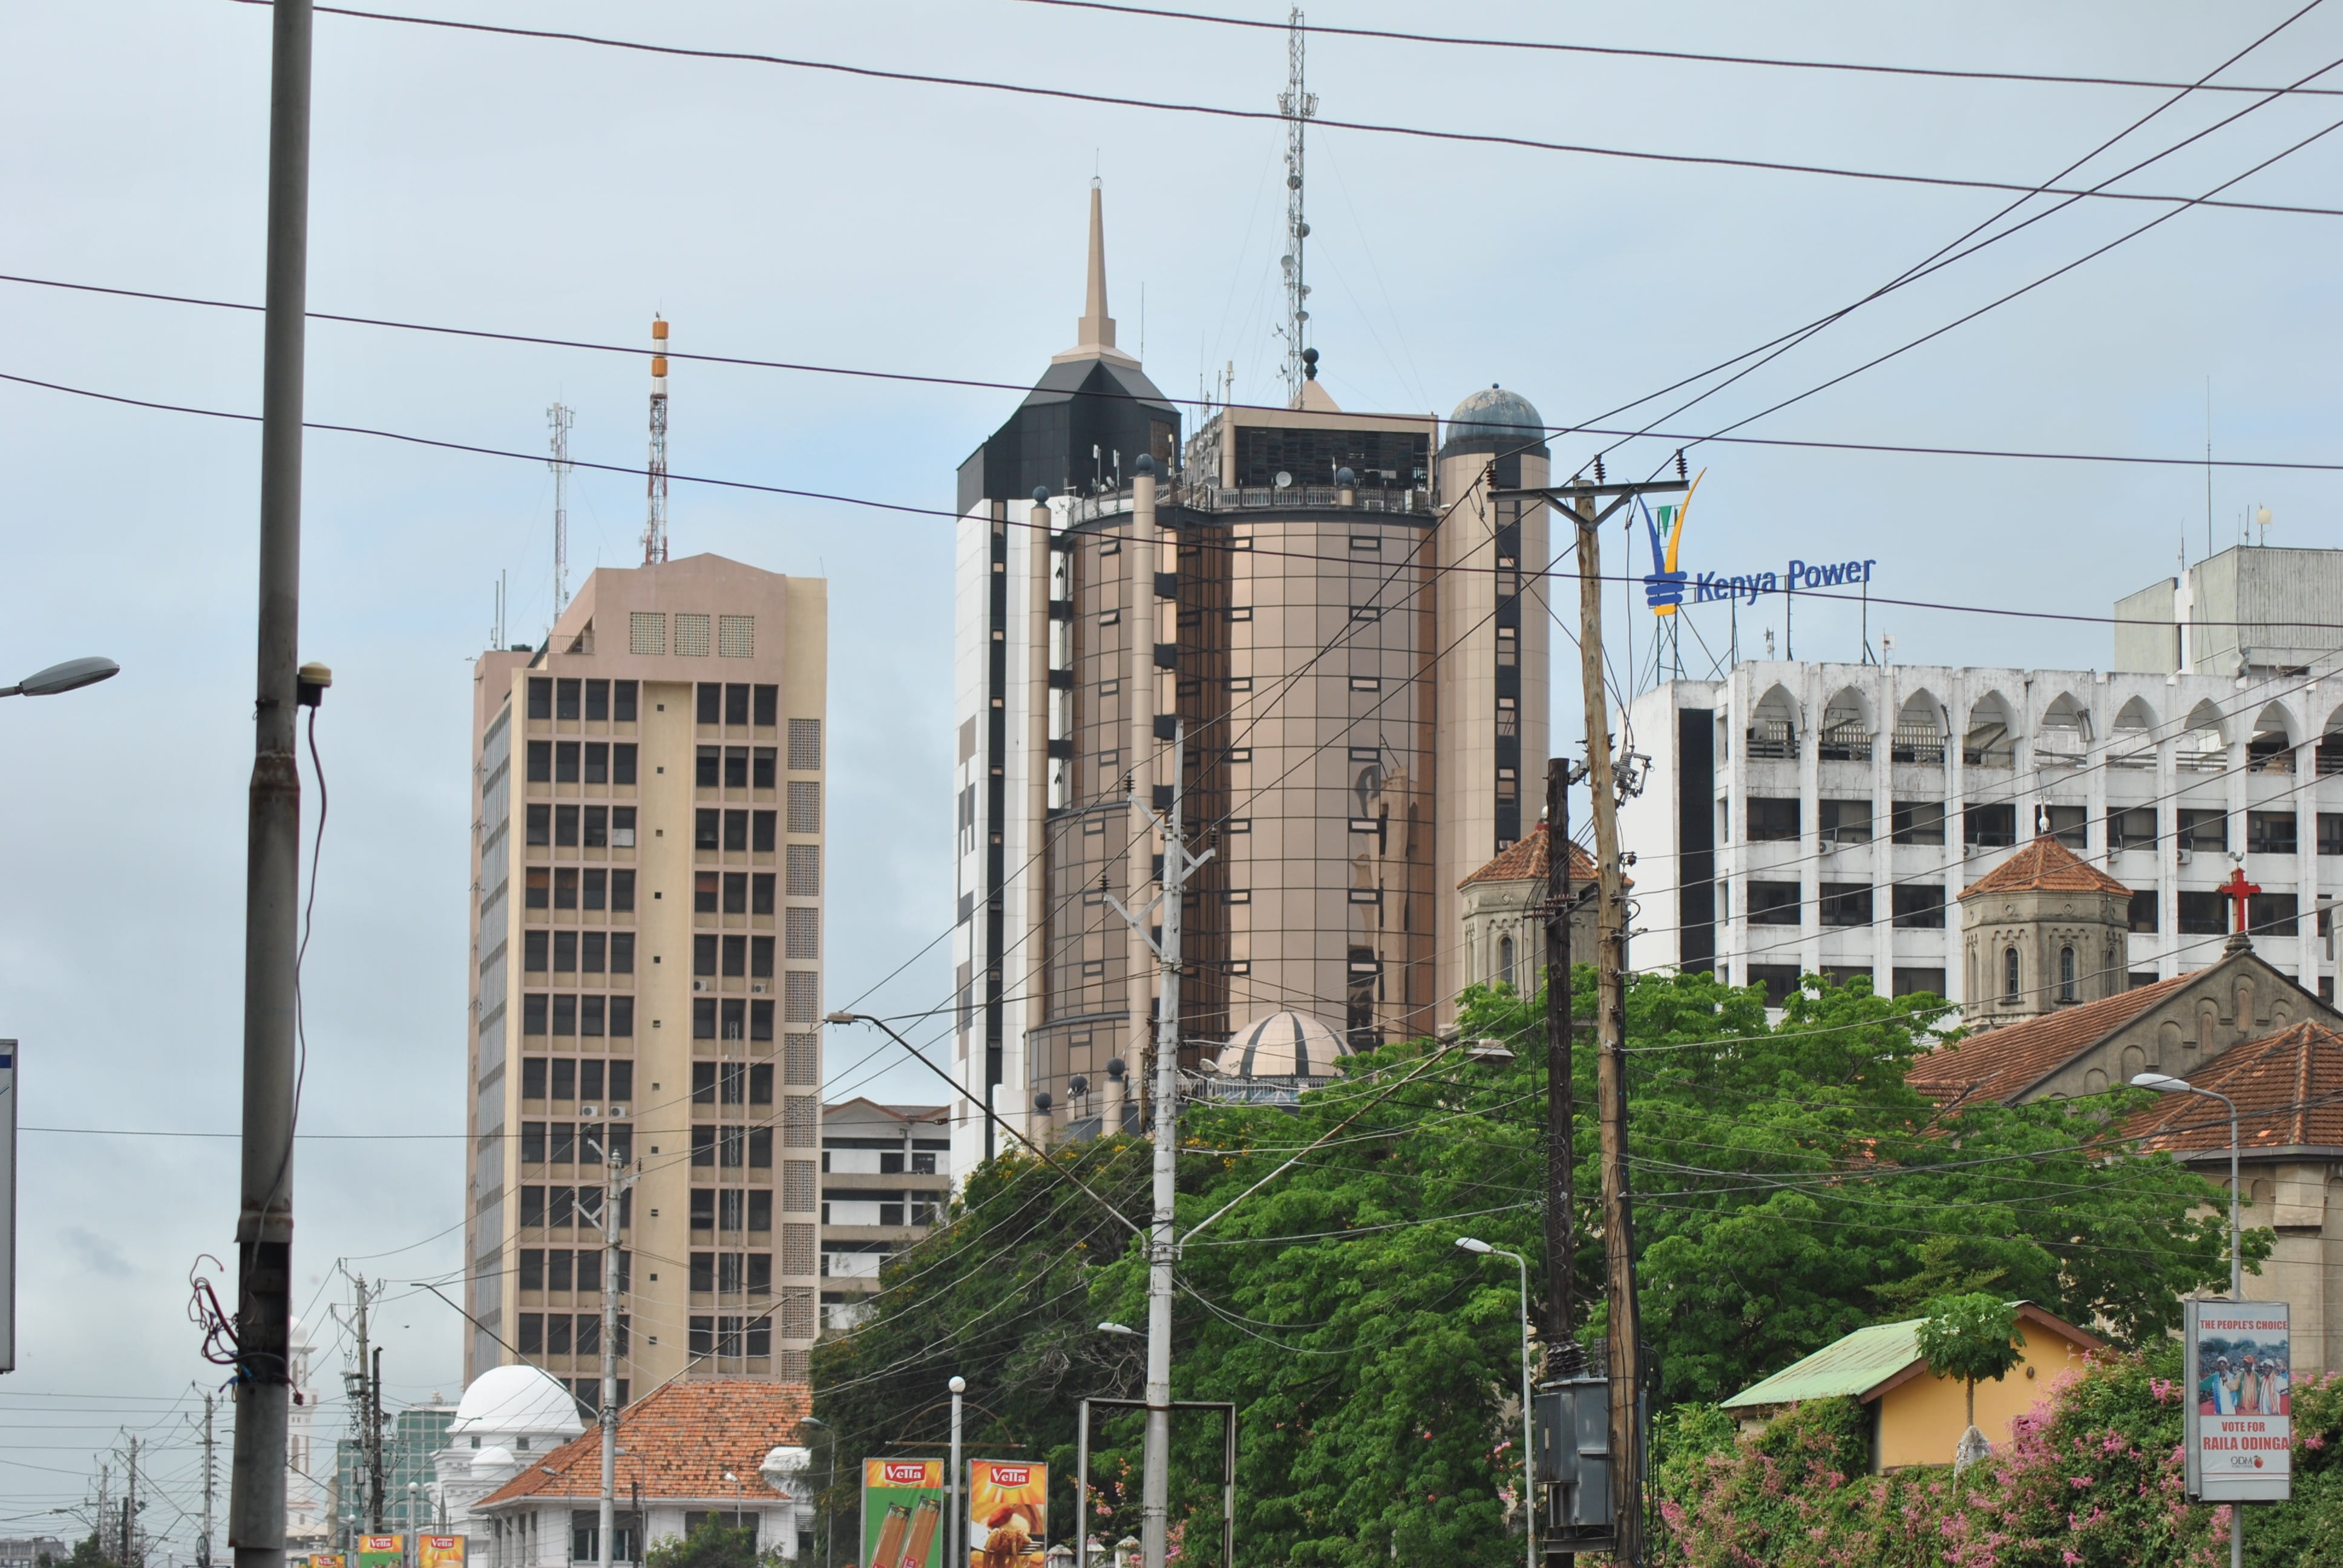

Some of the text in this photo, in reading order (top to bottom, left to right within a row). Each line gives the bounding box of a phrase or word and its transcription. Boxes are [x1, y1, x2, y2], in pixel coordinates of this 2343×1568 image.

[1696, 560, 1876, 606] Kenya Power
[2200, 1320, 2288, 1330] THE PEOPLE'S CHOICE
[2221, 1422, 2265, 1432] VOTE FOR
[2203, 1437, 2290, 1451] RAILA ODINGA
[2230, 1456, 2253, 1465] ODM
[886, 1465, 923, 1479] Vella
[992, 1468, 1027, 1482] Vella
